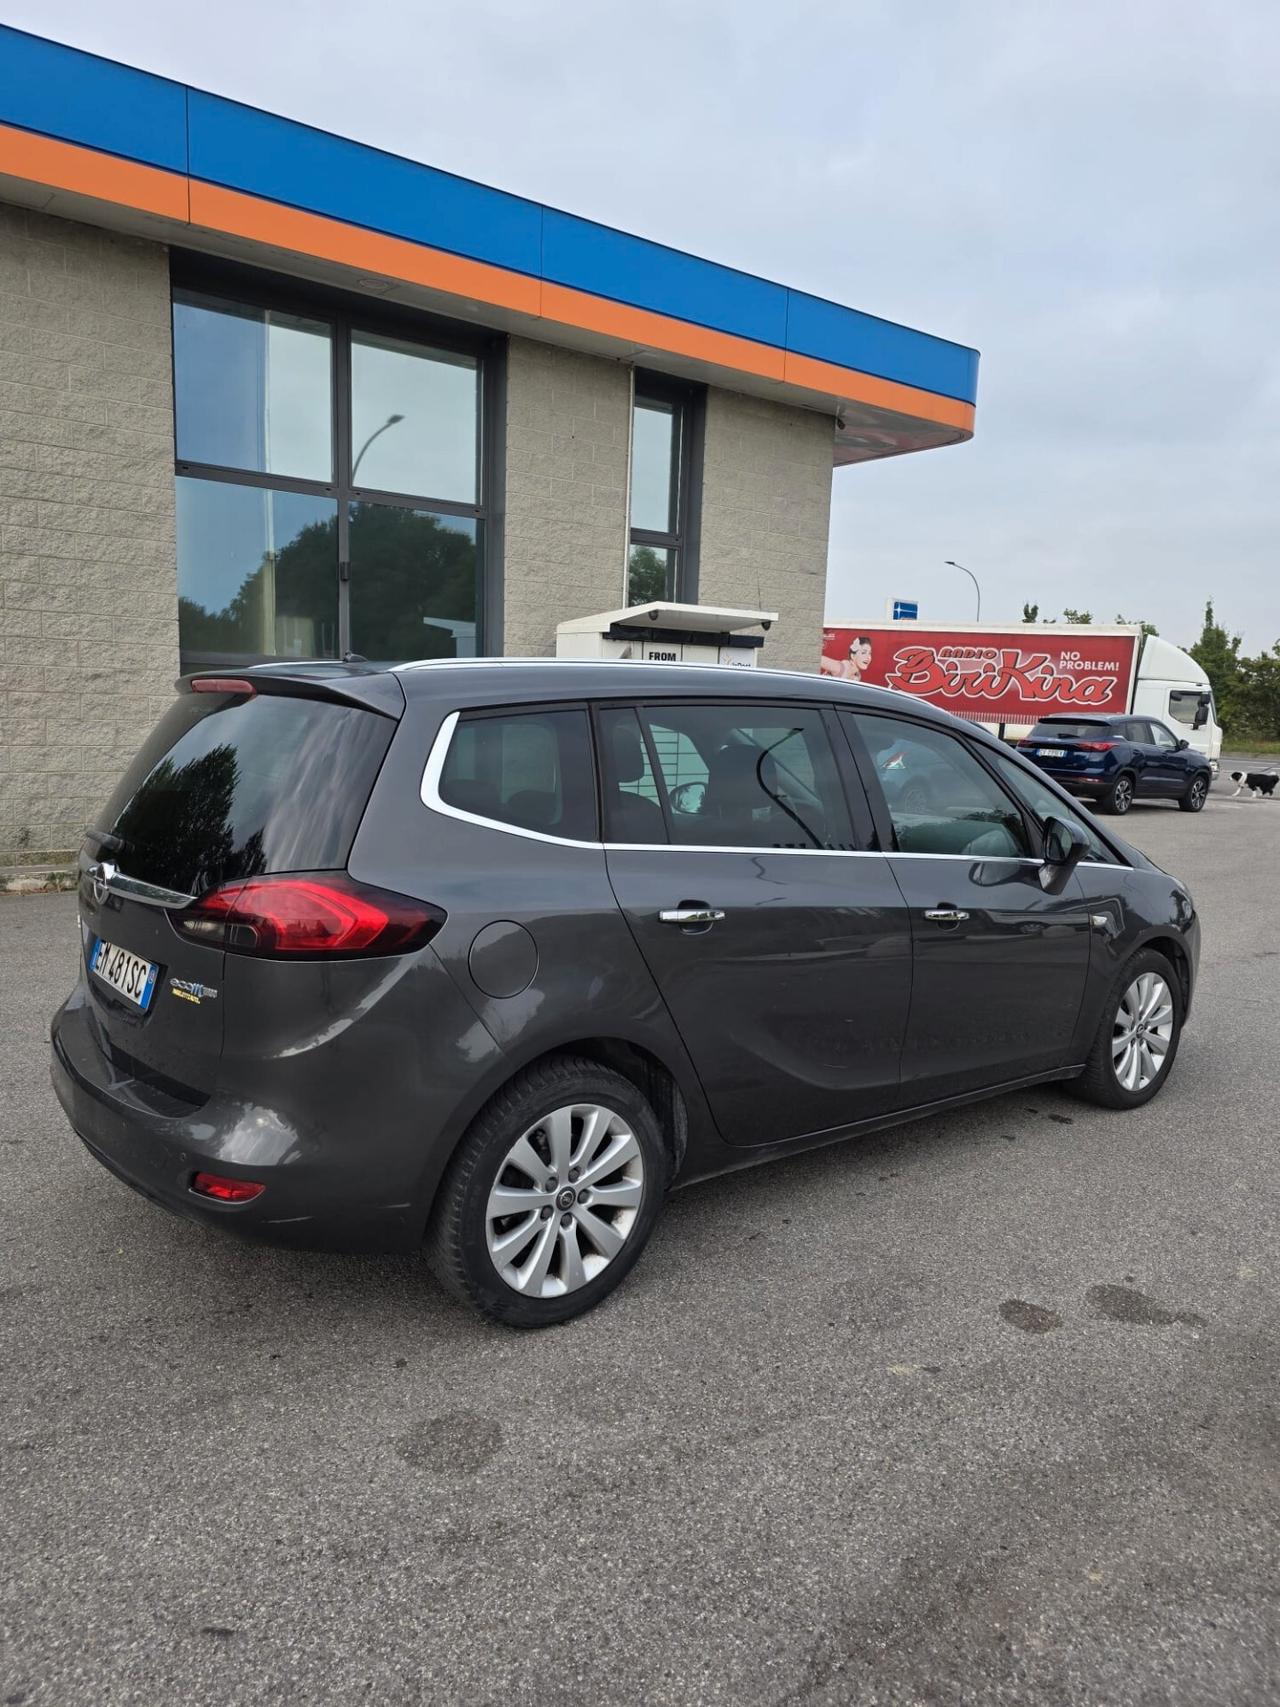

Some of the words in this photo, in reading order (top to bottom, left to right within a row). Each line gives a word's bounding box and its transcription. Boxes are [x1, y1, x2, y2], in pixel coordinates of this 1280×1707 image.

[649, 651, 677, 661] FROM
[939, 648, 997, 661] RADIO
[1060, 651, 1081, 661] NO
[1059, 660, 1120, 672] PROBLEM!
[108, 948, 147, 998] 481SC
